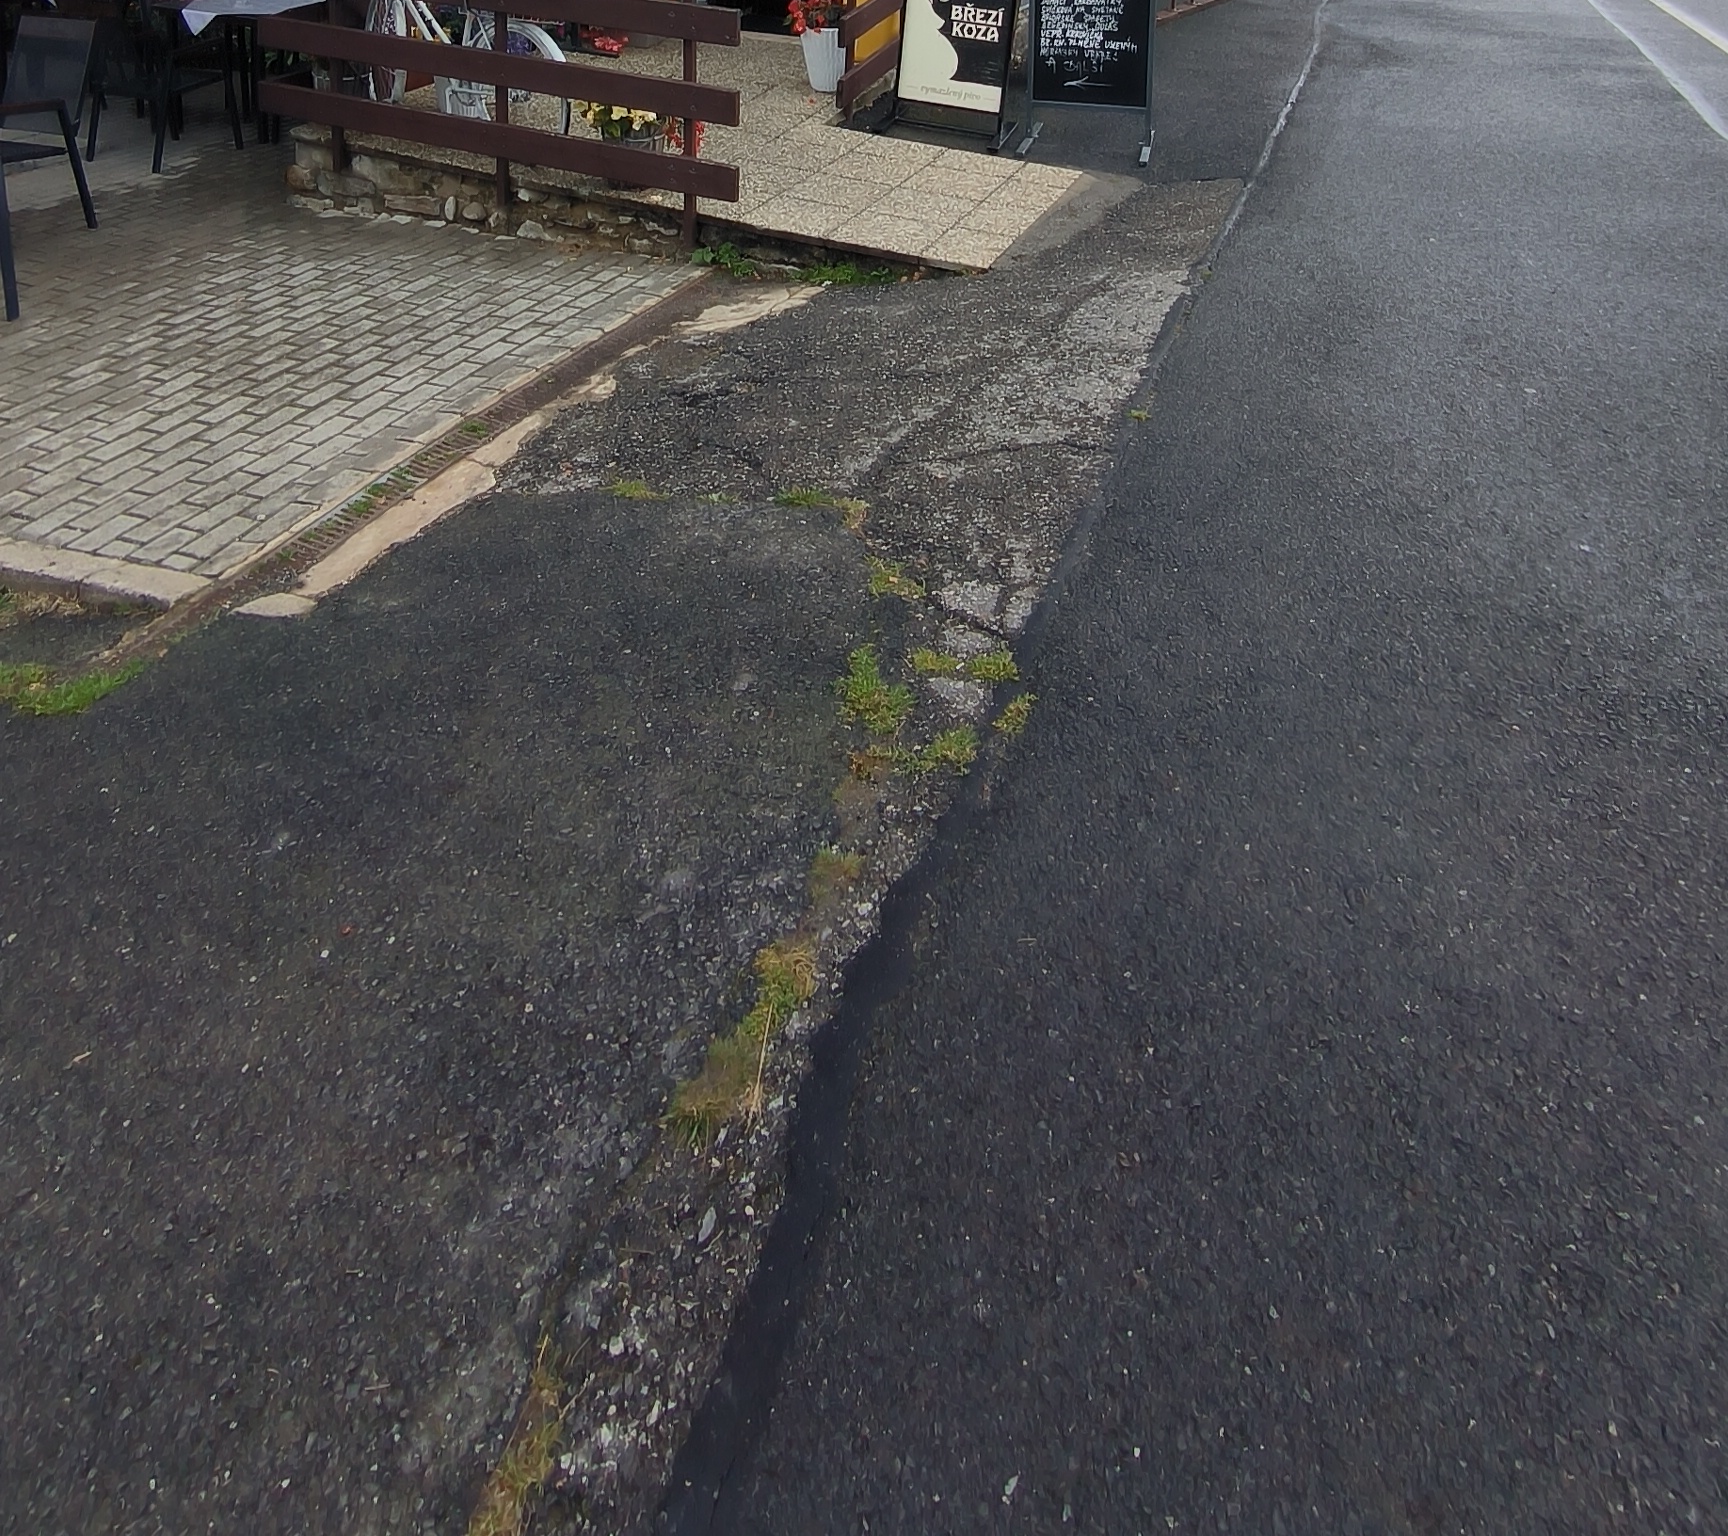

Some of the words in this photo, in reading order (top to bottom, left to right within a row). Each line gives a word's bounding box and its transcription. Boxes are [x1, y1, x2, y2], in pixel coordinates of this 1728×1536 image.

[950, 2, 1005, 27] BŘEZÍ
[951, 22, 1000, 43] KOZA
[963, 91, 981, 101] pivo
